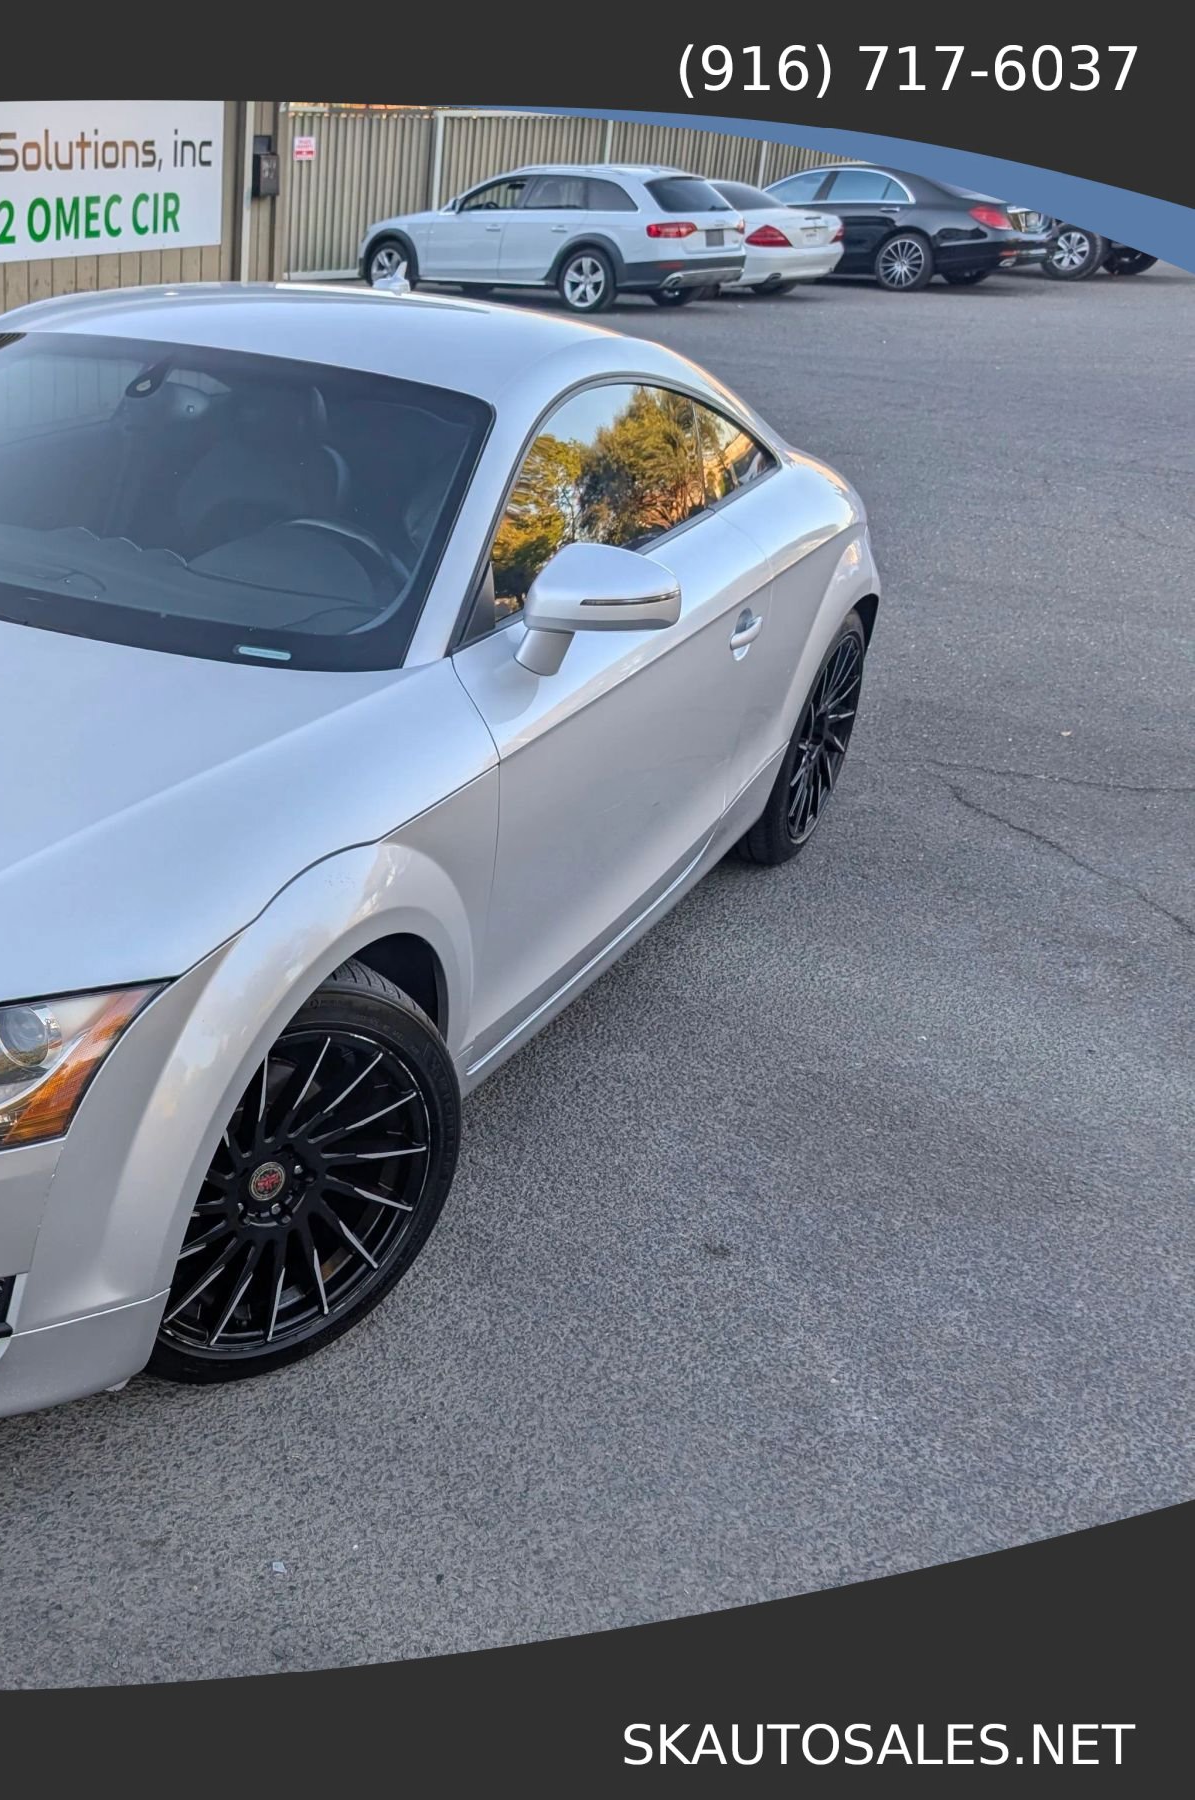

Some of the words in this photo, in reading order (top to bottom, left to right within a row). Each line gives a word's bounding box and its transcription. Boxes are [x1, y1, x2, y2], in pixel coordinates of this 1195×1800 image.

[173, 128, 213, 168] inc
[26, 193, 123, 242] OMEC
[131, 191, 181, 236] CIR
